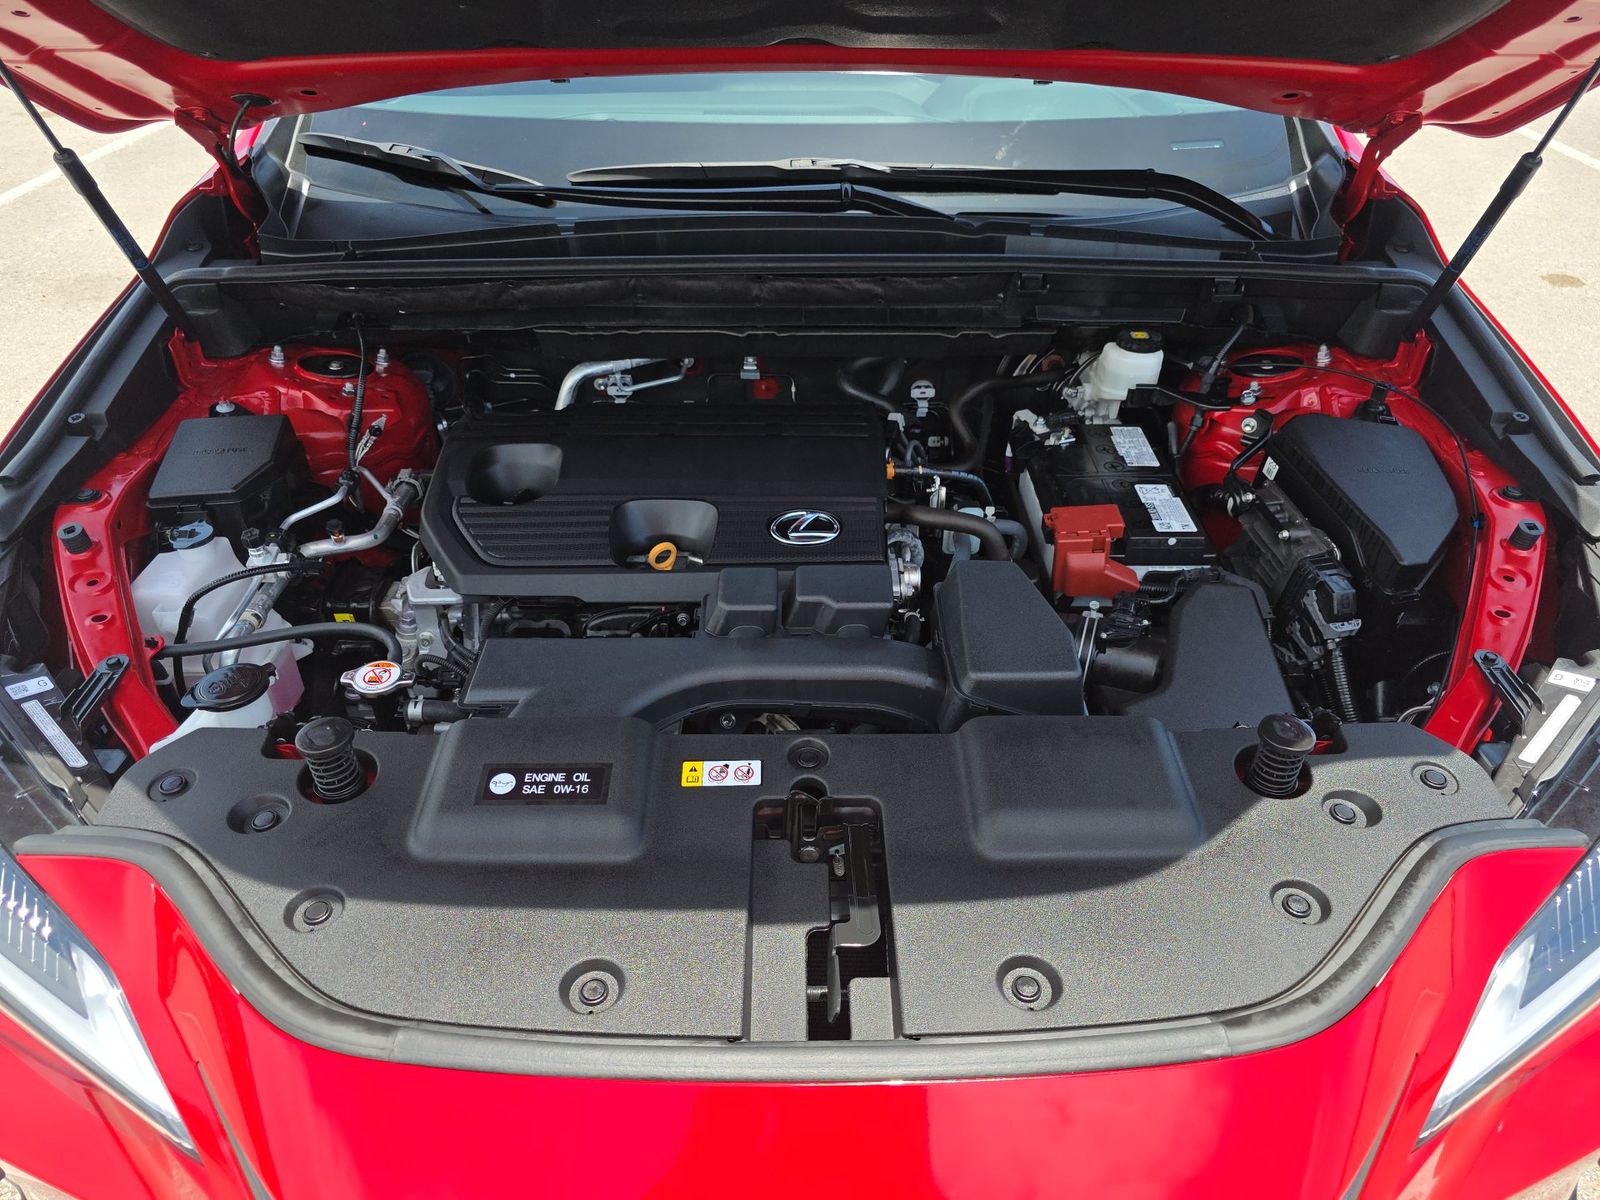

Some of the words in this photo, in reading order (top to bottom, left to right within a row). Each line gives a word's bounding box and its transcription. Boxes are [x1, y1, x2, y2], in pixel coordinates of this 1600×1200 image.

[524, 772, 566, 782] ENGINE
[572, 772, 591, 782] OIL
[522, 784, 546, 794] SAE
[553, 784, 589, 794] 0W-16
